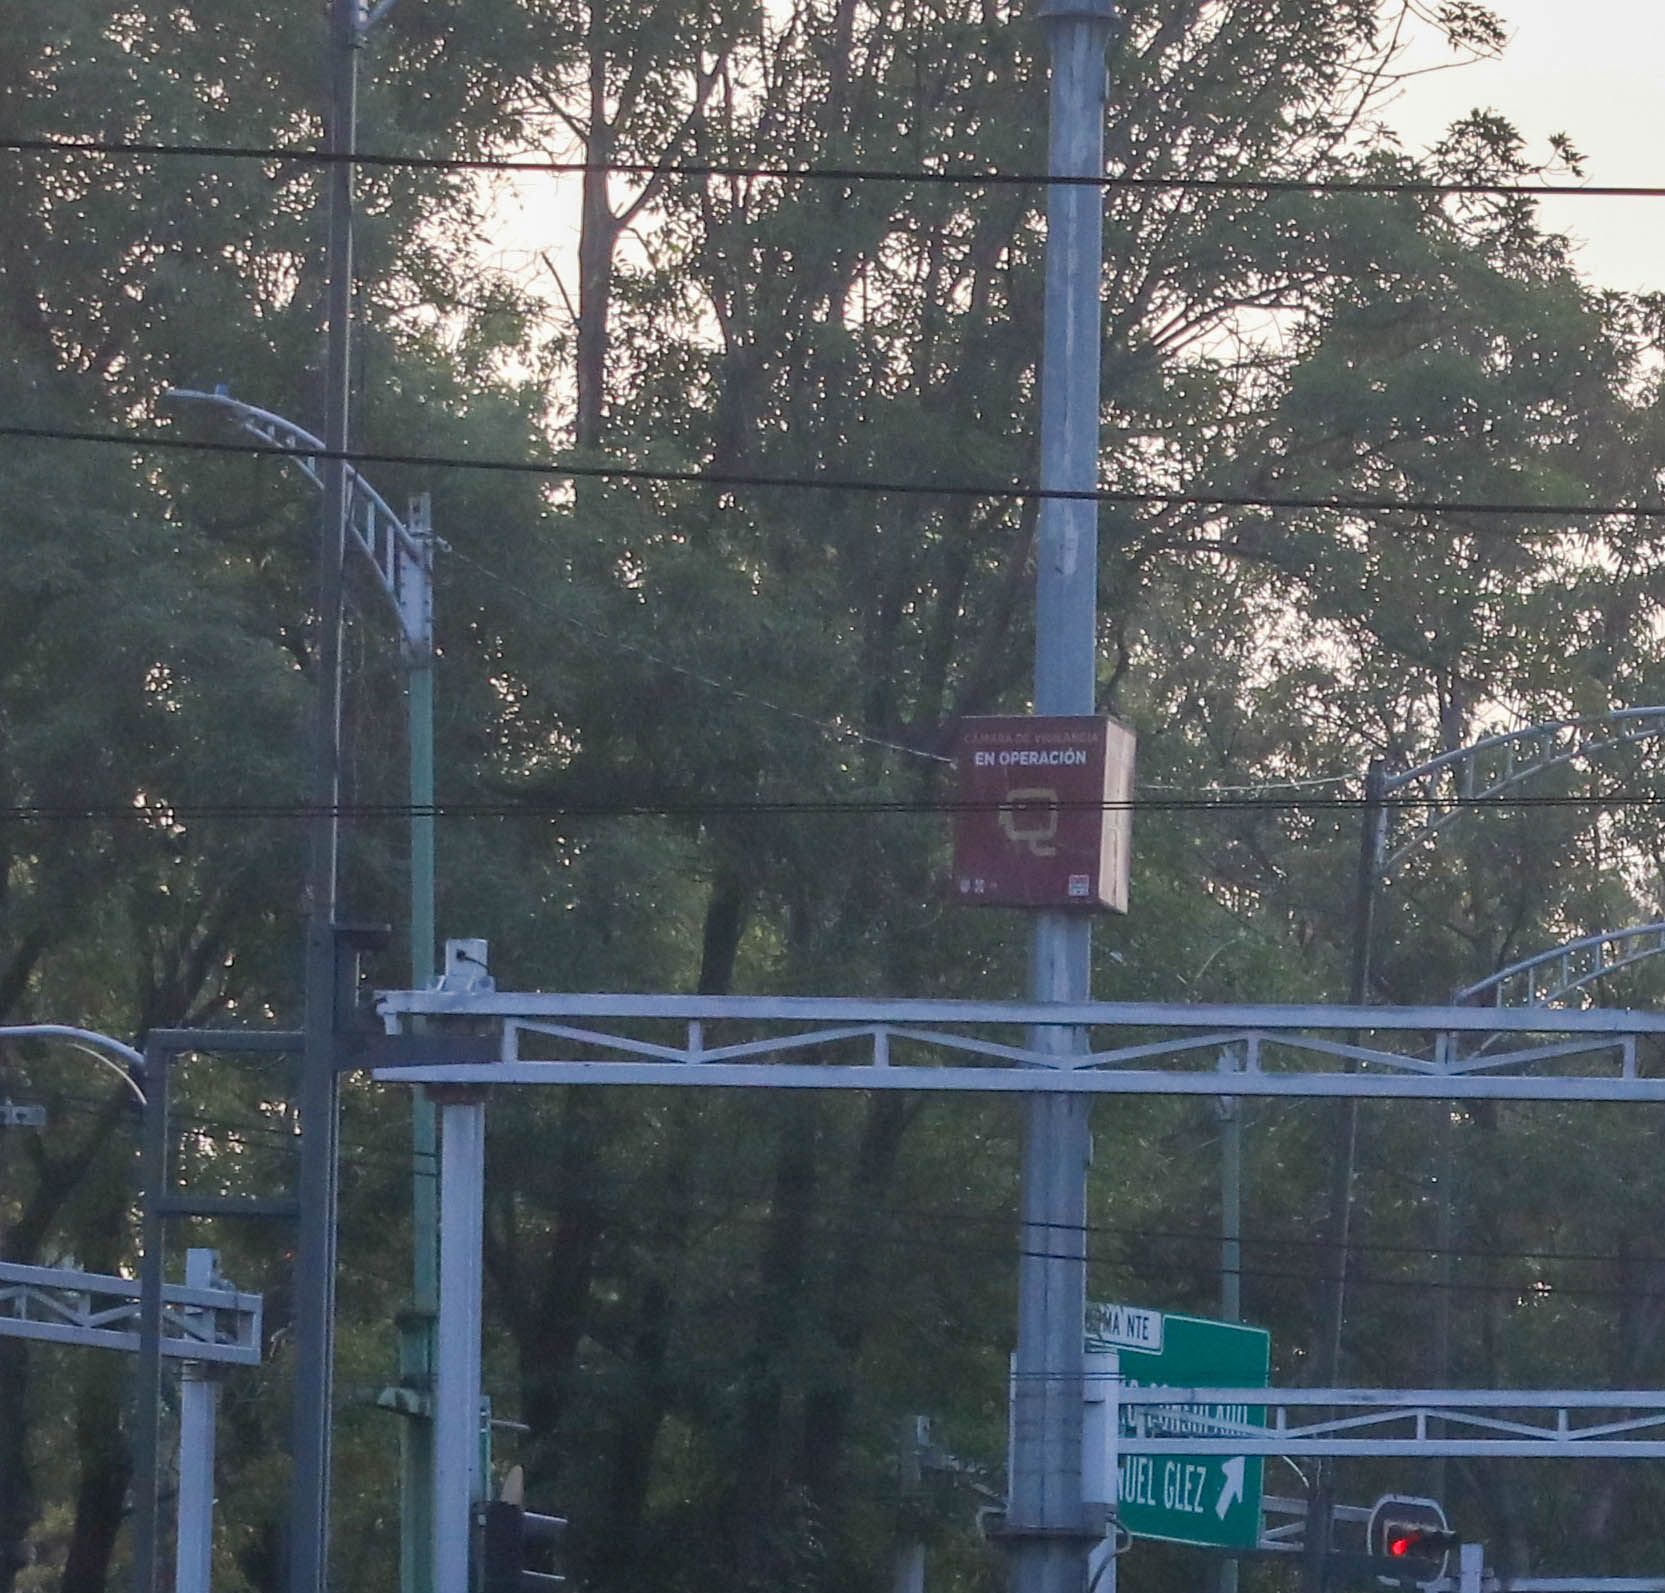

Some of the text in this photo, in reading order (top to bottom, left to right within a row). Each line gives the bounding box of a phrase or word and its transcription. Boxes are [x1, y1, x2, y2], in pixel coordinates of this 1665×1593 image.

[975, 748, 1087, 766] EN OPERACIÓN
[1127, 1314, 1149, 1341] NTE
[1164, 1460, 1207, 1513] GLEZ
